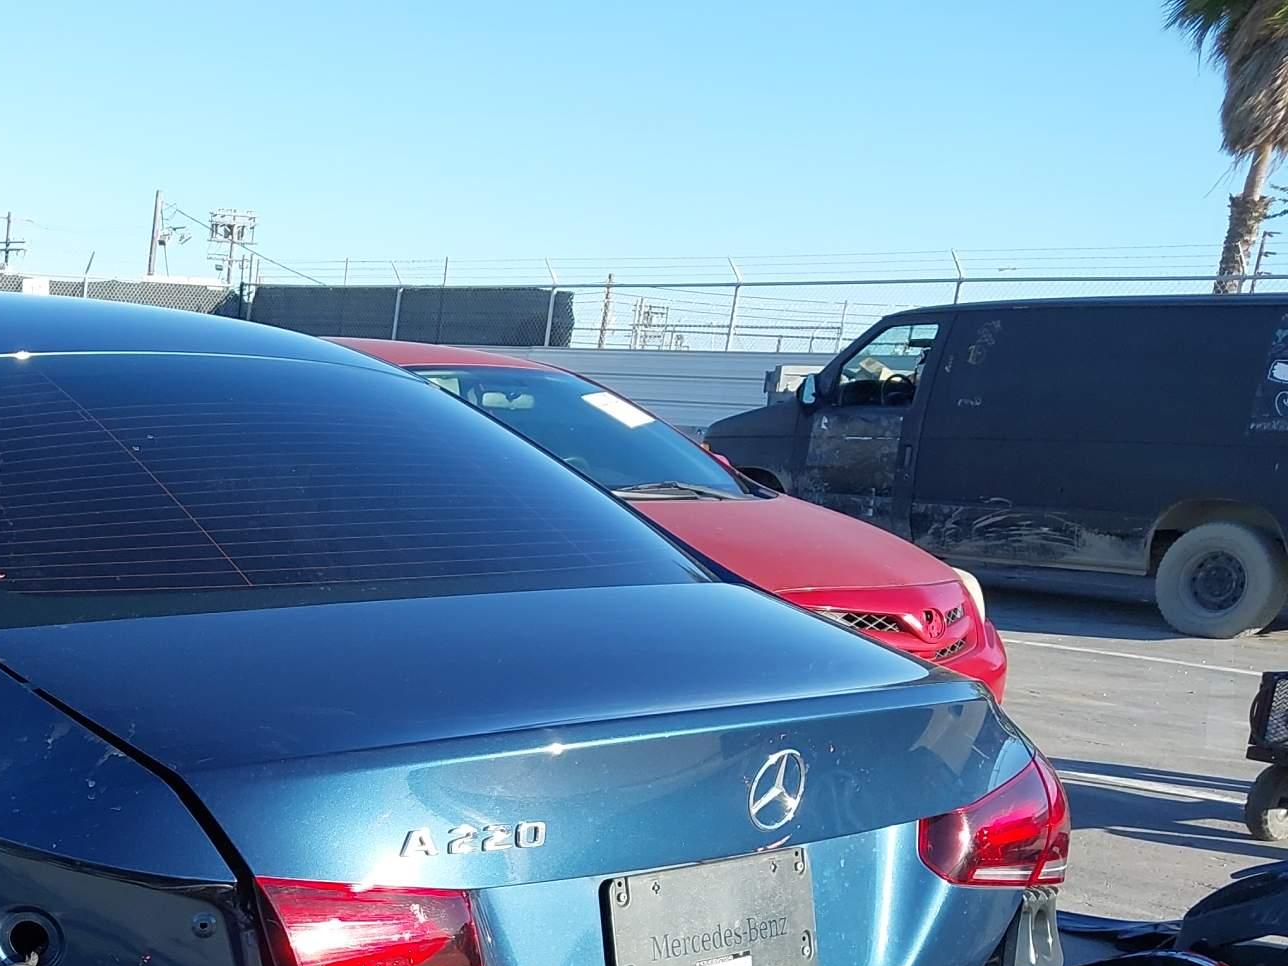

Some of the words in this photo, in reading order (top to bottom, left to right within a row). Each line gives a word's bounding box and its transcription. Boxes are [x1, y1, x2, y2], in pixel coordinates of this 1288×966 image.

[399, 826, 439, 857] A
[447, 821, 547, 855] 220
[650, 916, 789, 962] Mercedes-Benz
